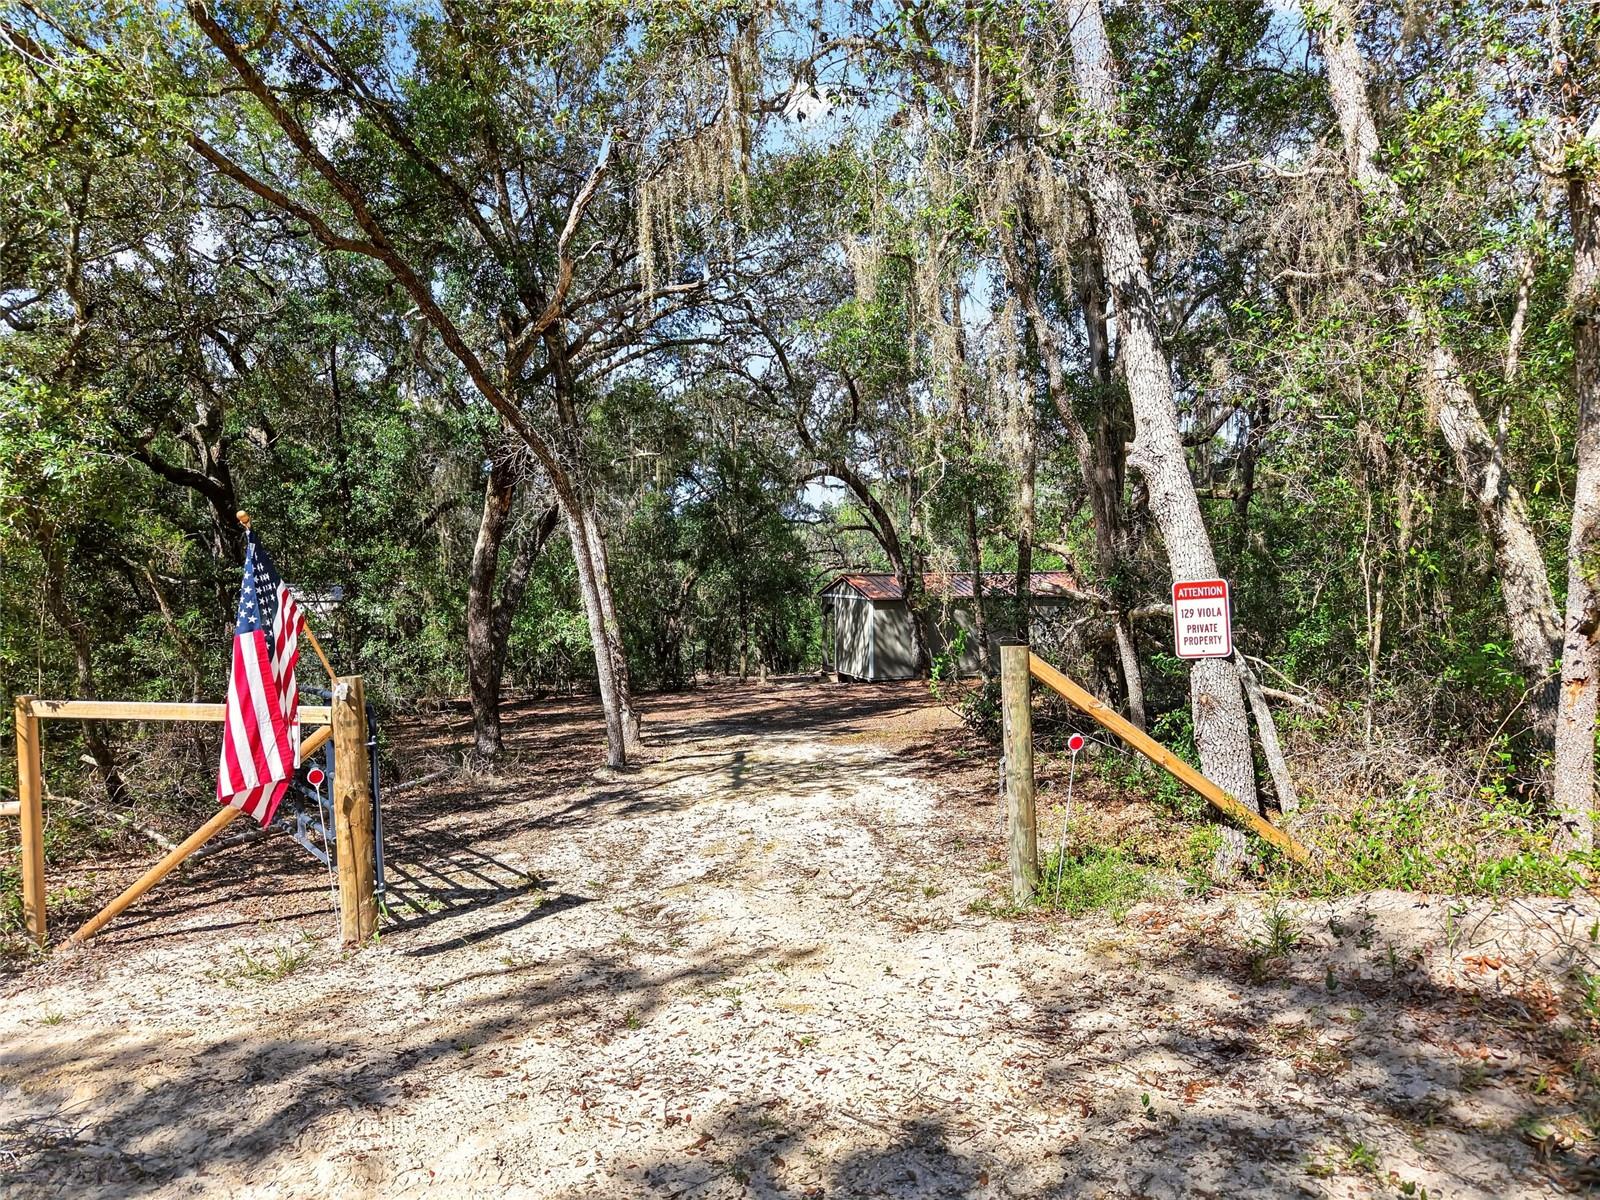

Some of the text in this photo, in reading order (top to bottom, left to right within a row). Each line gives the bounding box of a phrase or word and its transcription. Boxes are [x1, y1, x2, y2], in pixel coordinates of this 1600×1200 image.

[1178, 586, 1223, 597] ATTENTION
[1181, 607, 1222, 619] 129 VIOLA
[1186, 623, 1218, 634] PRIVATE
[1183, 635, 1222, 646] PROPERTY
